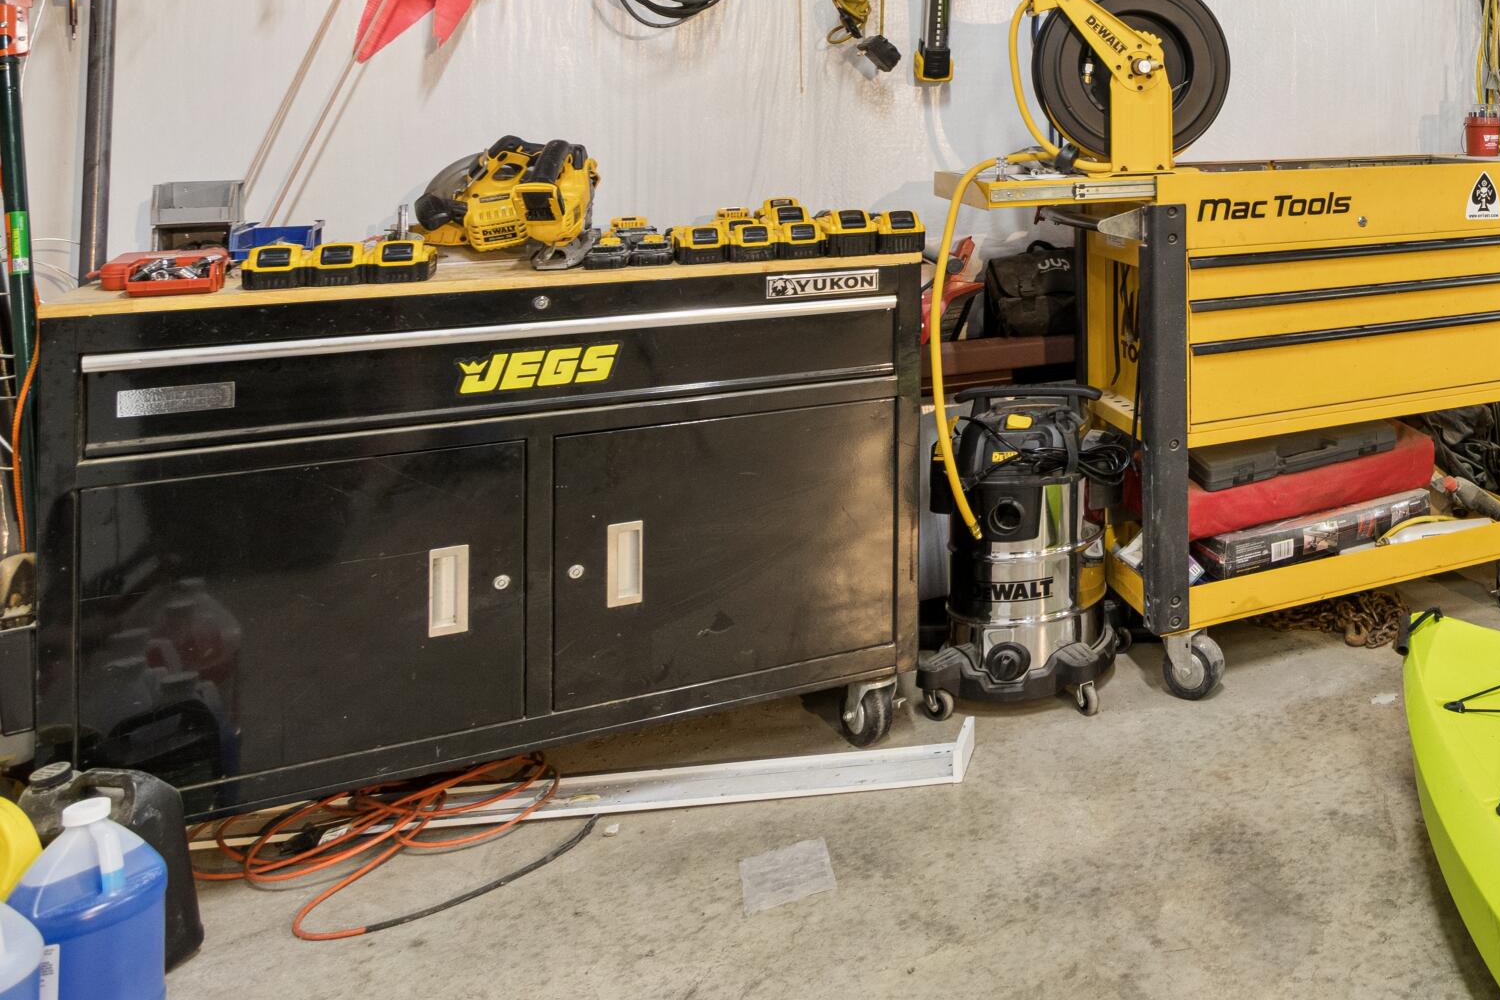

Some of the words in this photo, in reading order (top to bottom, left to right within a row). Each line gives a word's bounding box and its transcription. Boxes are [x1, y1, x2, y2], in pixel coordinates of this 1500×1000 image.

[1273, 191, 1352, 217] Tools
[795, 275, 874, 293] YUKON
[459, 344, 619, 394] JEGS
